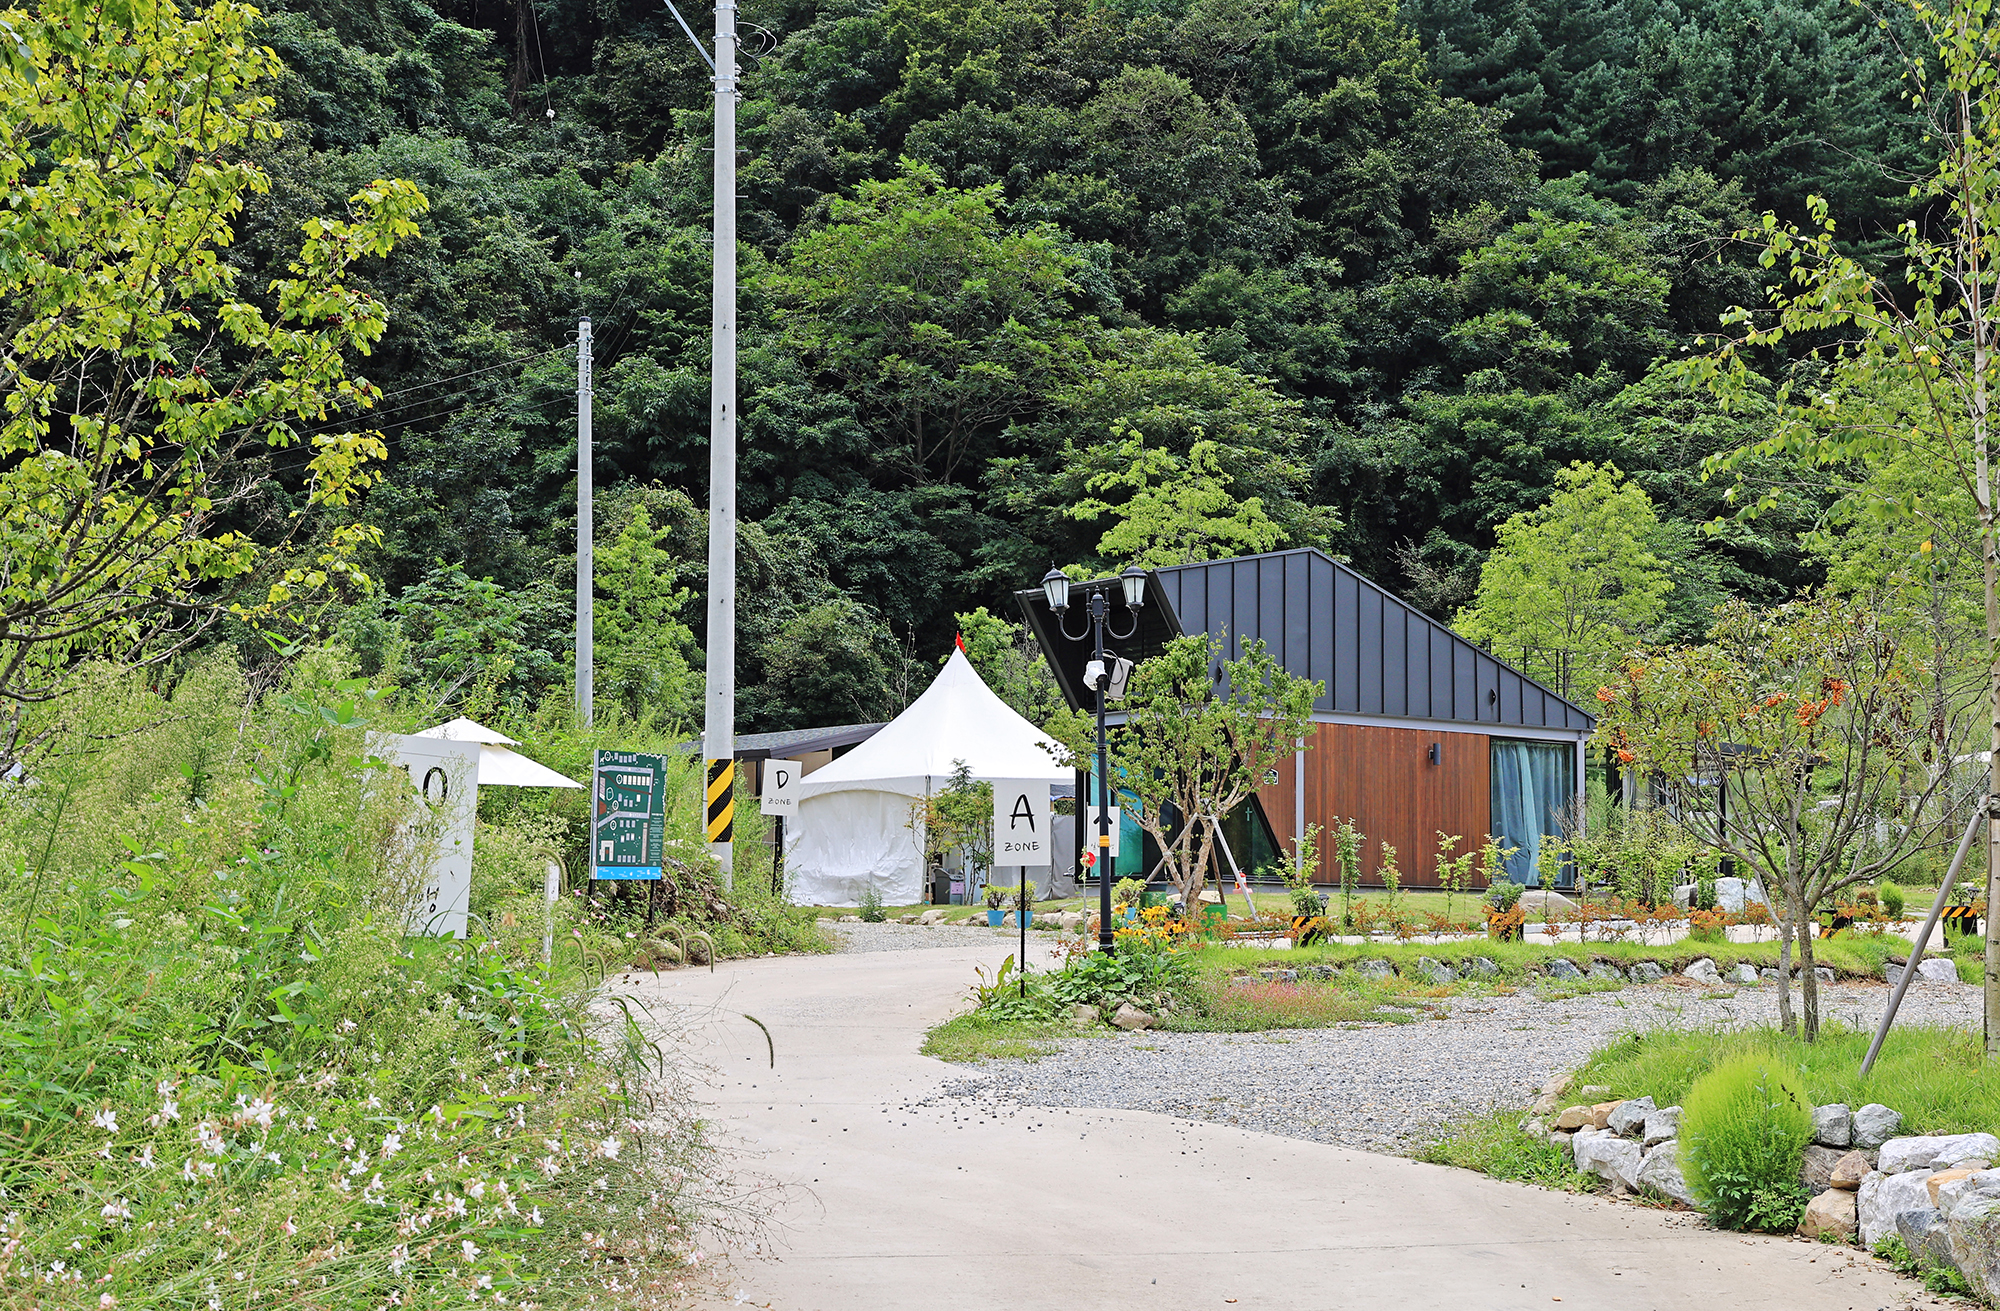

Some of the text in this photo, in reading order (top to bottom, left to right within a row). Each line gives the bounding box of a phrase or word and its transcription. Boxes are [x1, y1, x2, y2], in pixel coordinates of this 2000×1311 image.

[776, 770, 789, 790] D
[768, 798, 791, 806] ZONE
[1009, 794, 1035, 833] A
[1004, 841, 1040, 852] ZONE
